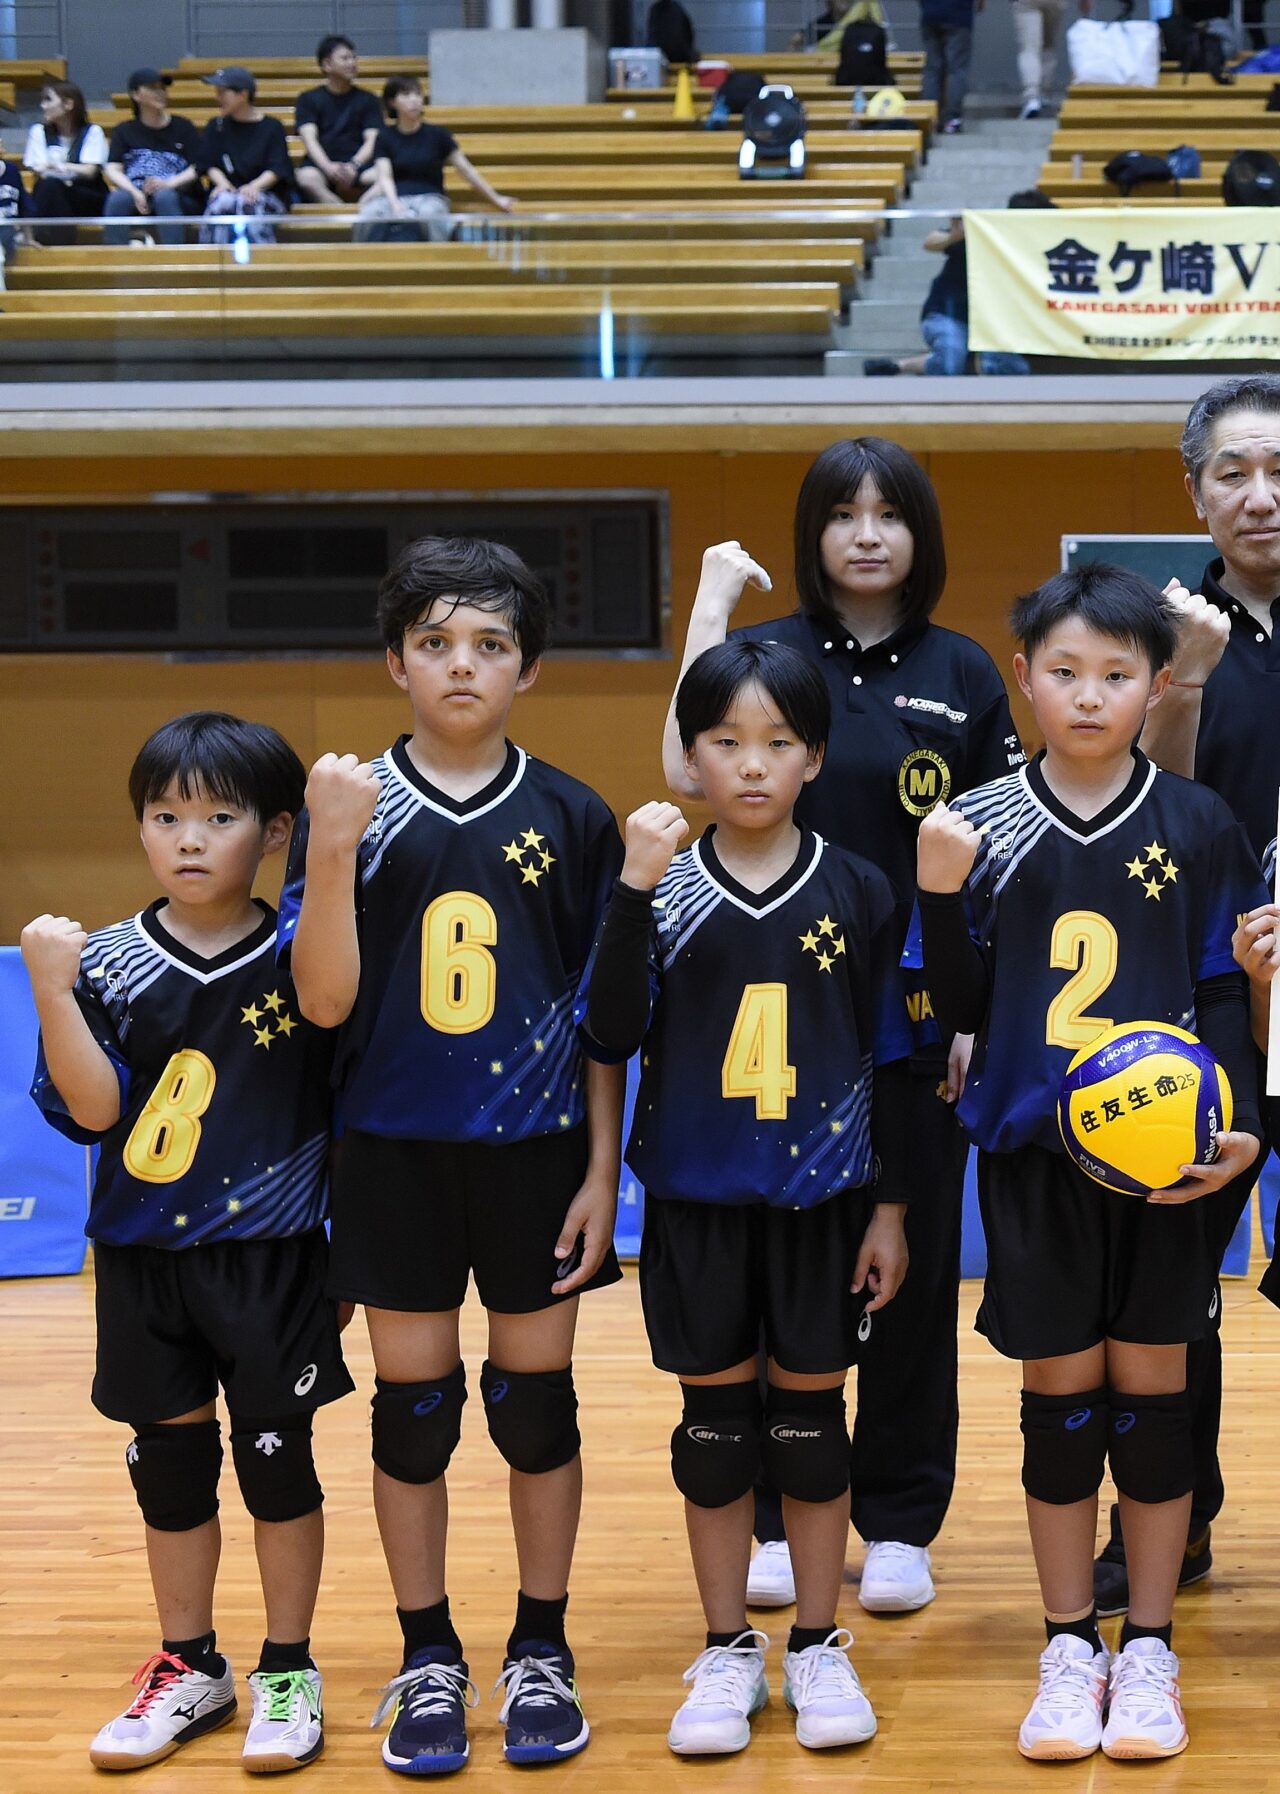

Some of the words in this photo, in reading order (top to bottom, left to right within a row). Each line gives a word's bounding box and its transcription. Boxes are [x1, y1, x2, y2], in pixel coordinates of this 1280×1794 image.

[1047, 299, 1178, 314] KANEGASAKI
[902, 749, 947, 769] KANEGASAKI
[910, 768, 936, 796] M
[993, 850, 1014, 860] TRES
[420, 891, 498, 1035] 6
[1045, 911, 1118, 1050] 2
[721, 982, 796, 1120] 4
[1177, 1073, 1195, 1091] 25
[123, 1048, 217, 1184] 8
[1080, 1075, 1178, 1134] 住友生命
[1080, 1153, 1106, 1176] FIVB
